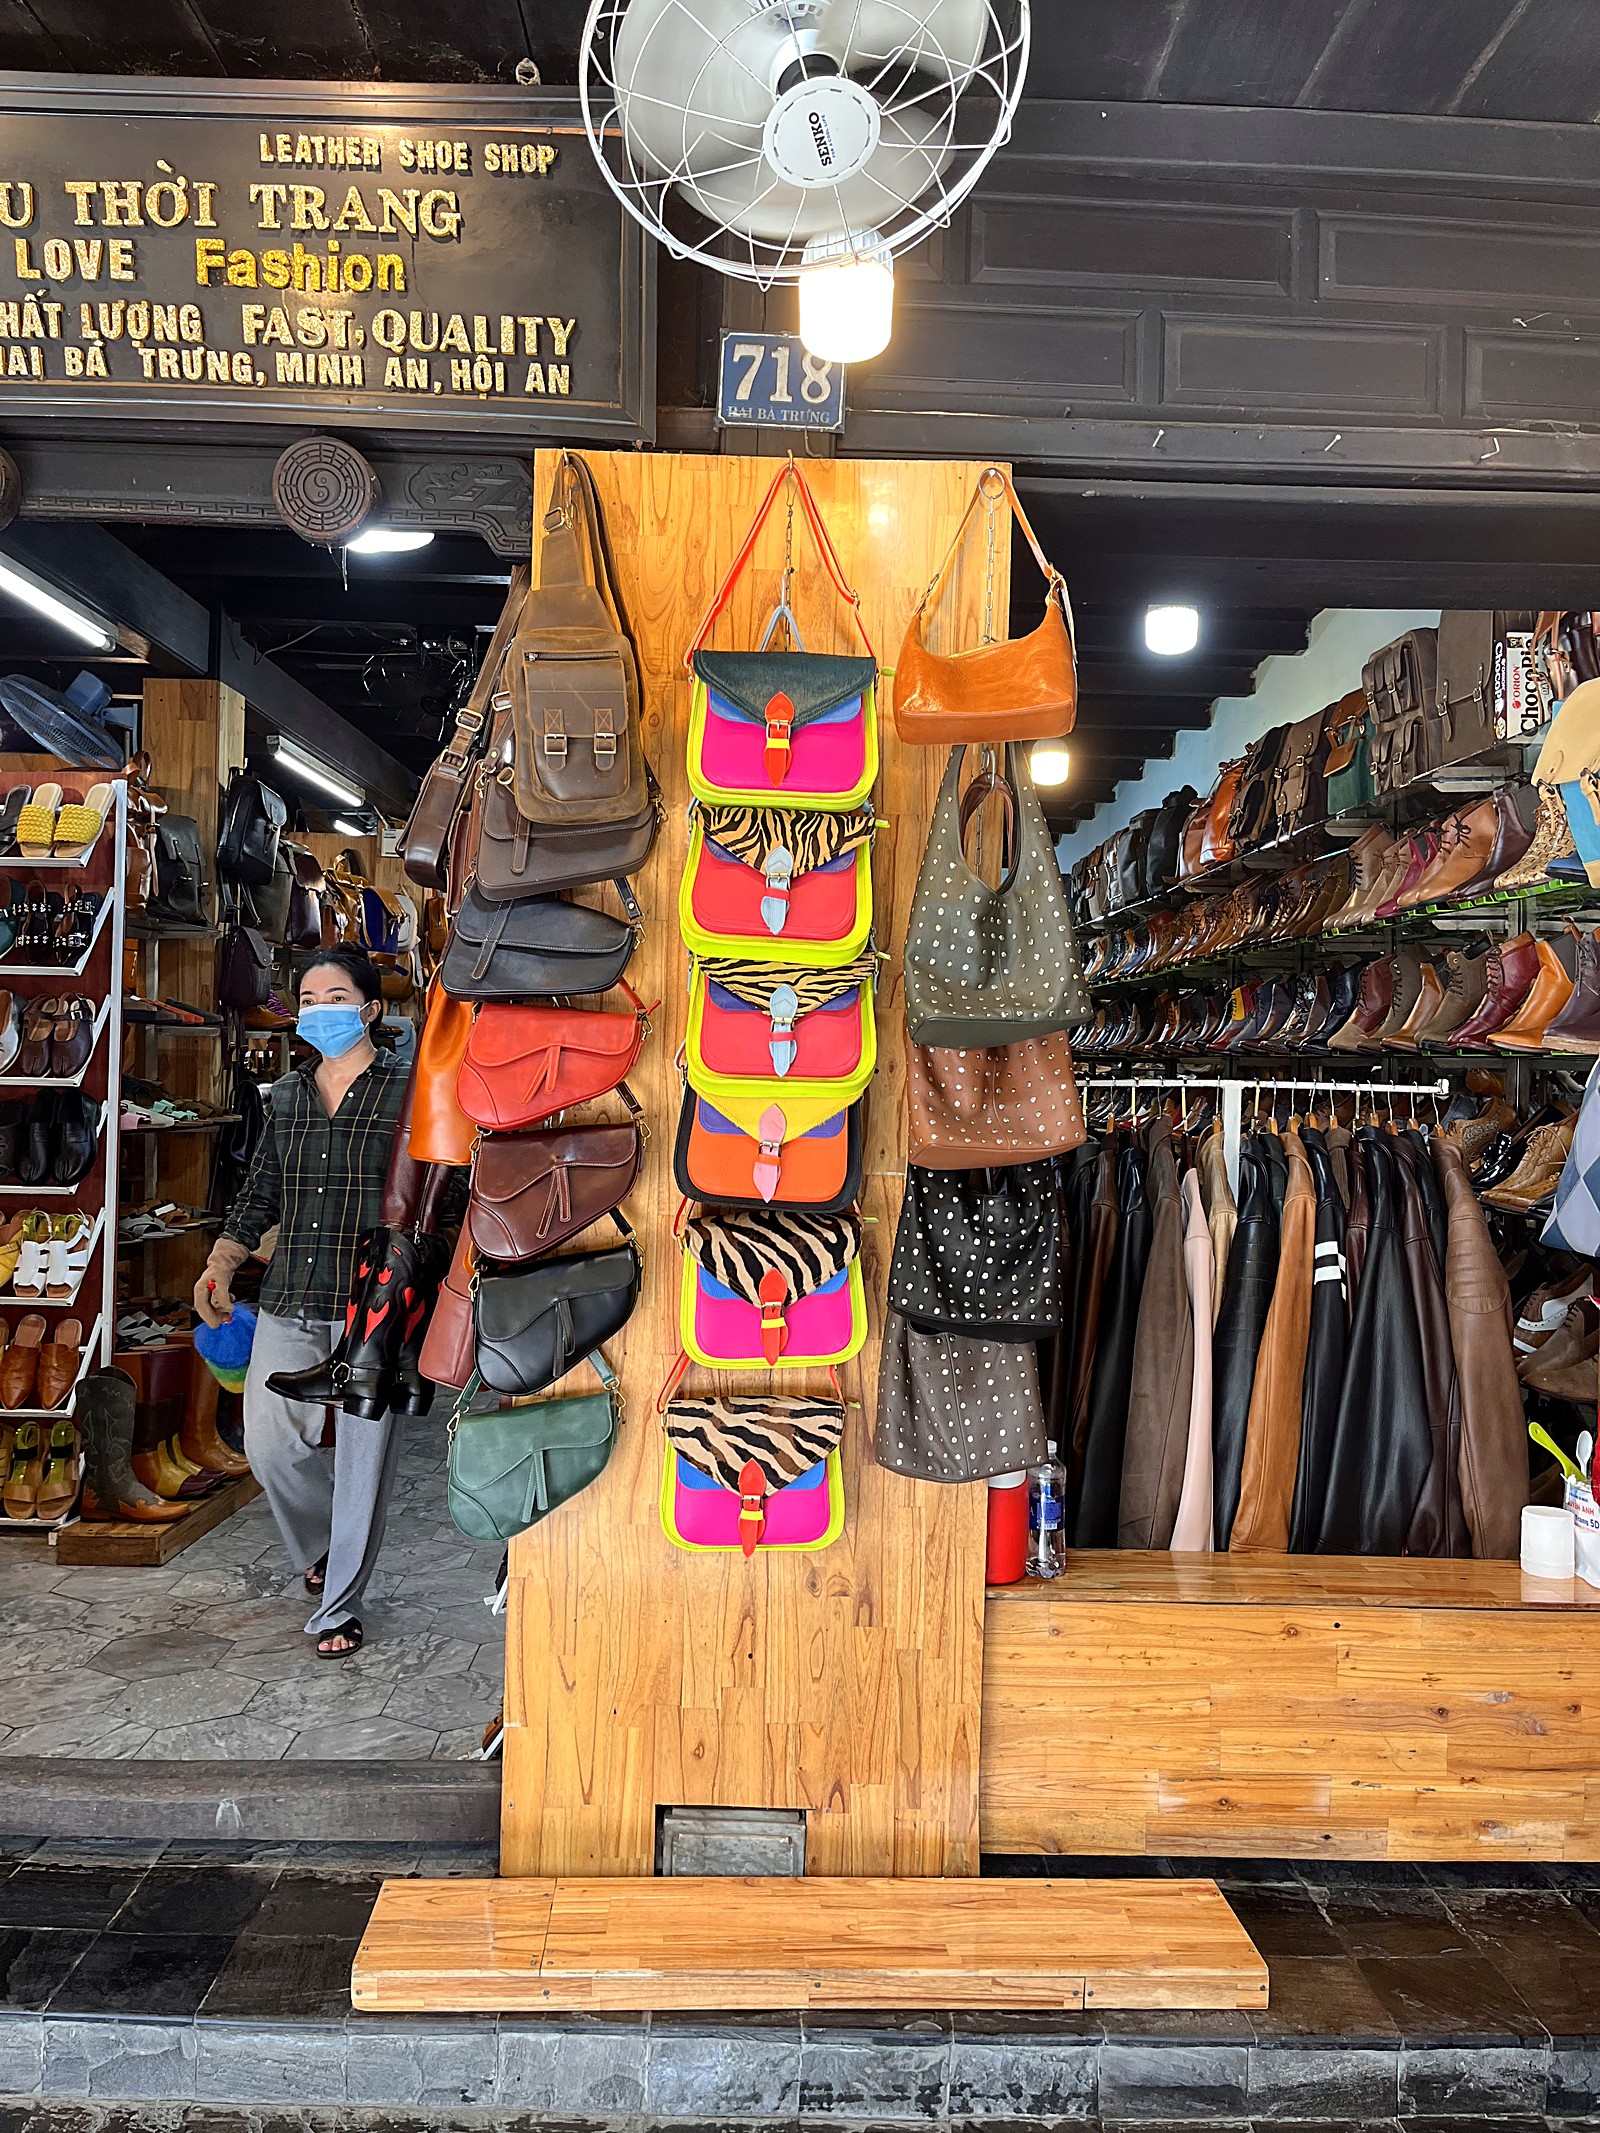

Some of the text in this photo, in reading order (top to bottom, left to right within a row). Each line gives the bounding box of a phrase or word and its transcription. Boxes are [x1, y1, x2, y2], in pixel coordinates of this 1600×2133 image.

[259, 133, 558, 176] LEATHER SHOE SHOP
[808, 112, 832, 167] SENKO
[65, 159, 218, 228] THỜI
[249, 182, 462, 239] TRANG
[15, 238, 407, 292] LOVE Fashion
[80, 299, 204, 348] LƯỢNG
[276, 350, 365, 387] MINH
[451, 354, 505, 401] HỘI
[524, 362, 571, 396] AN
[732, 343, 833, 404] 718
[757, 405, 776, 421] BÀ
[780, 408, 830, 423] TRƯNG
[1512, 666, 1520, 698] ORION
[1590, 1518, 1600, 1530] 5D
